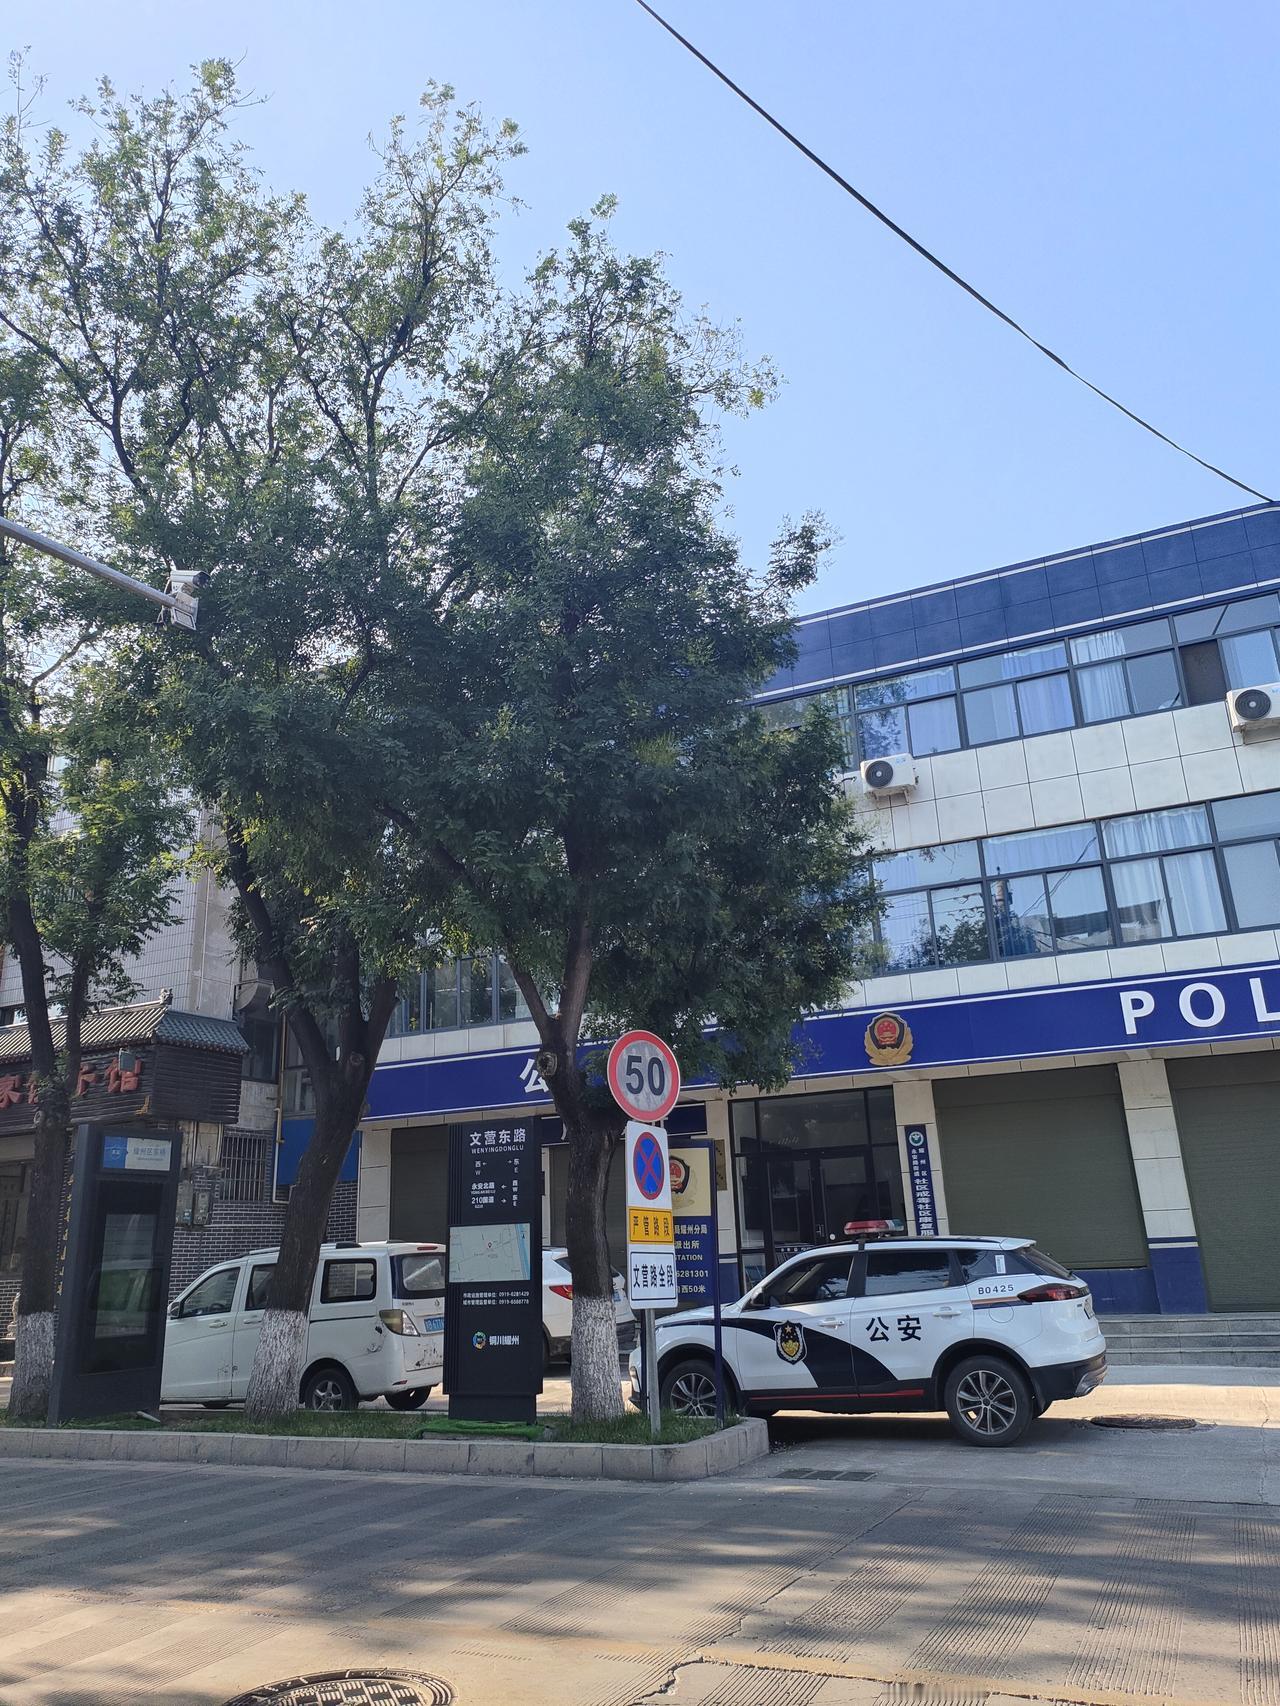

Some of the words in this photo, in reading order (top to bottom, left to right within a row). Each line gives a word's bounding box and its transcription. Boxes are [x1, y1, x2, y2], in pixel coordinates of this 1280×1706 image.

[1119, 977, 1280, 1036] POL
[625, 1055, 665, 1096] 50
[470, 1128, 526, 1146] 文营东路
[471, 1145, 524, 1154] WENYINGDONGLU
[633, 1215, 670, 1236] 严管路段
[633, 1264, 674, 1288] 文营路全段
[978, 1283, 1014, 1295] B0425
[865, 1314, 922, 1342] 公安
